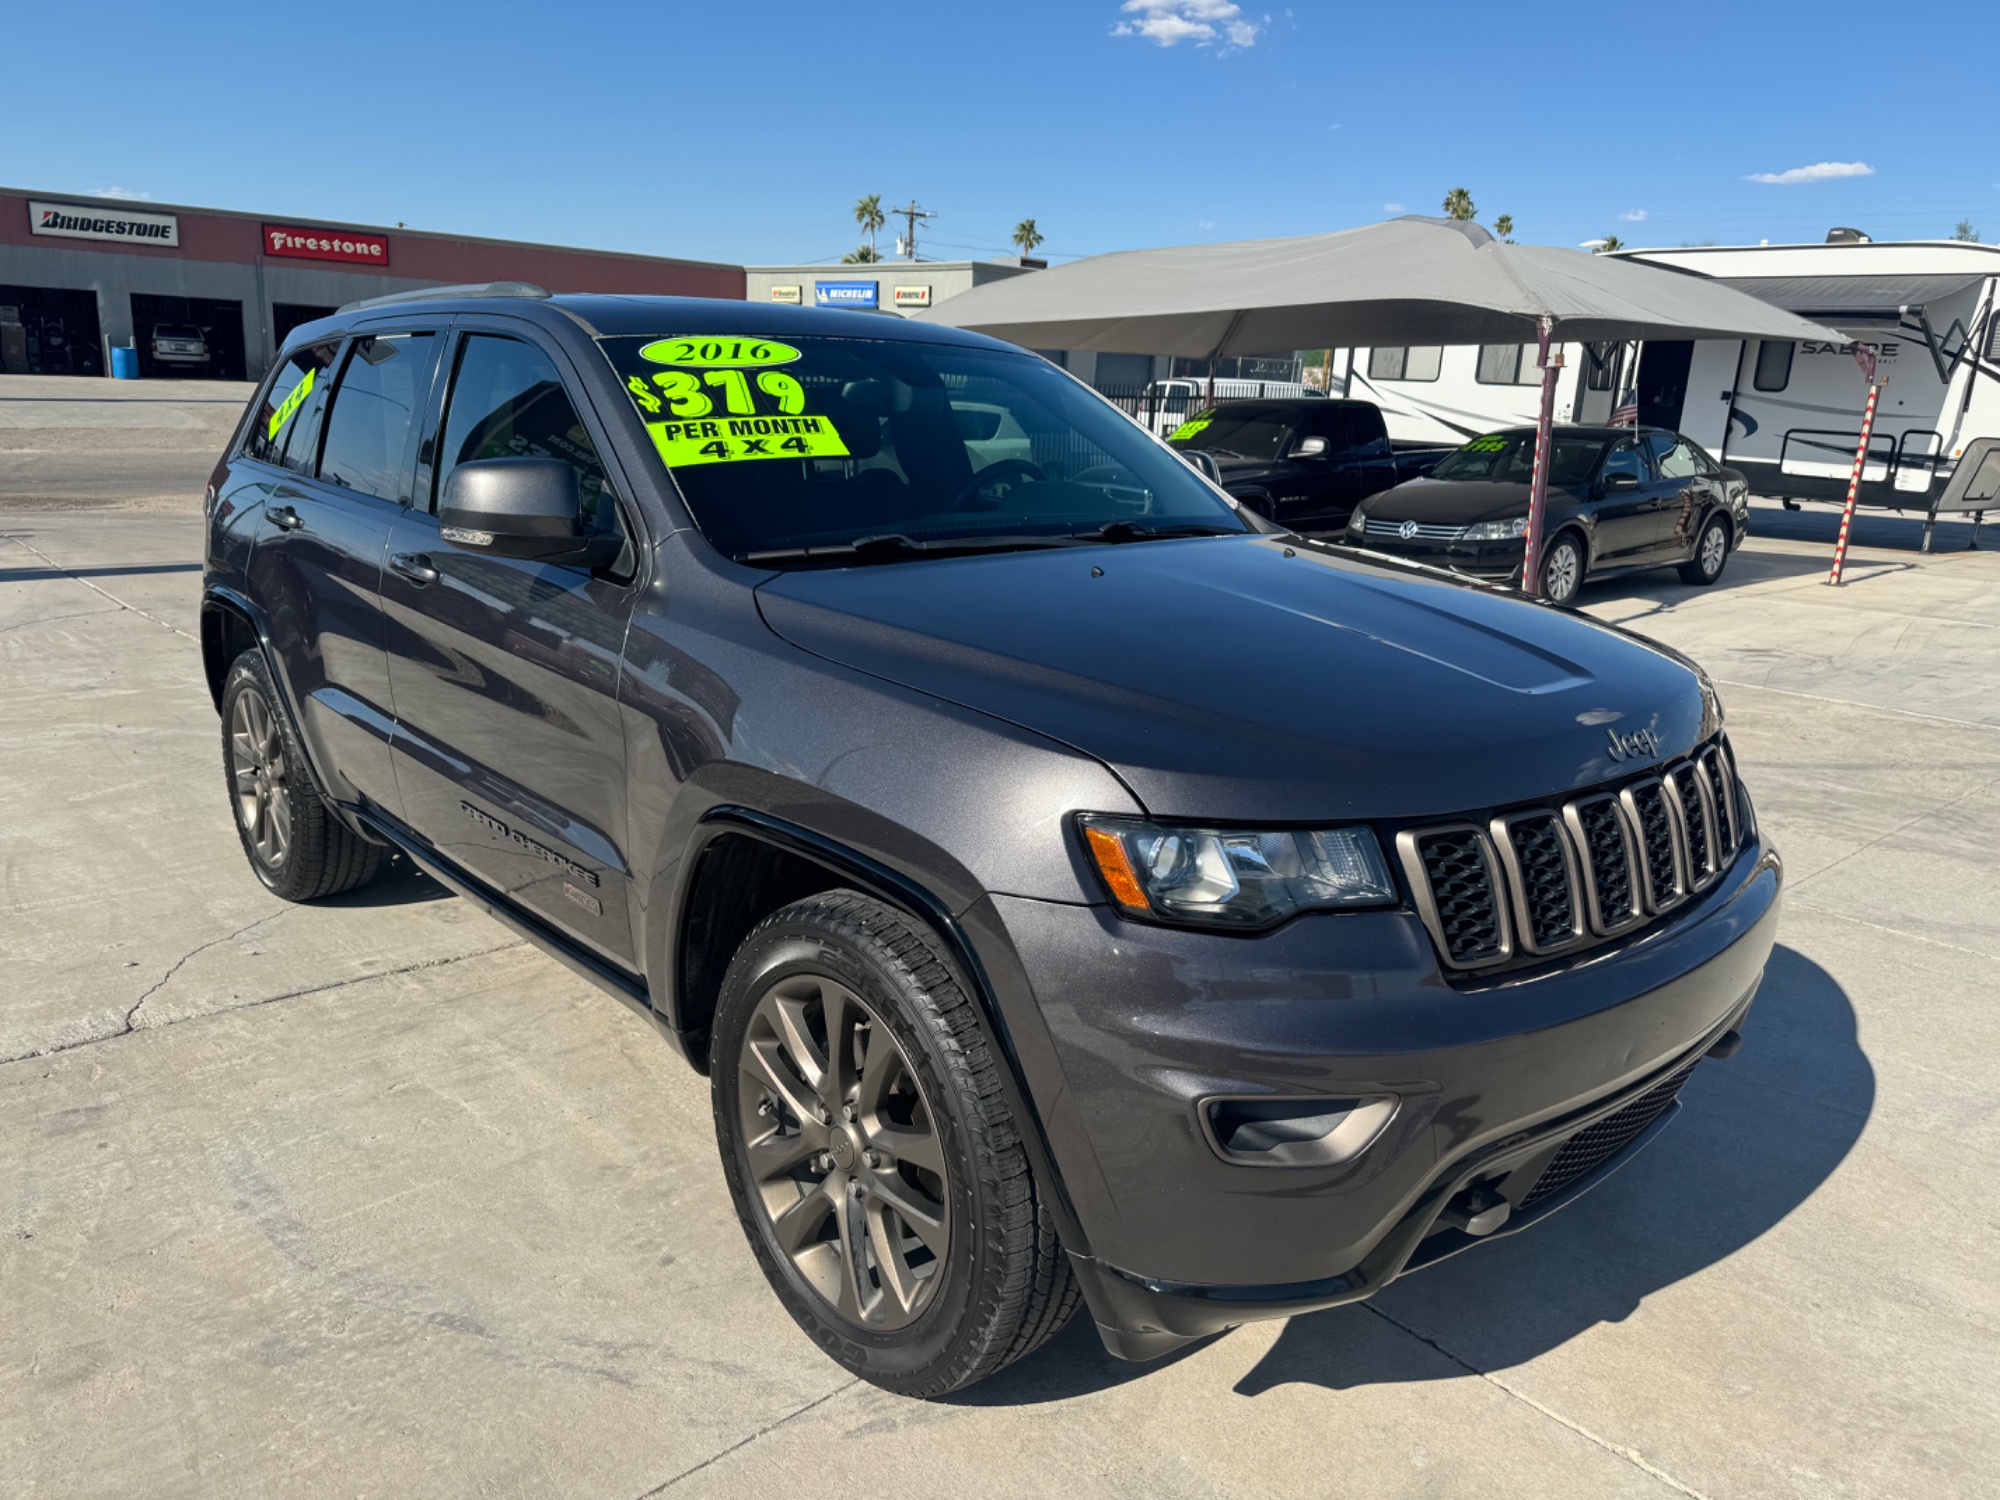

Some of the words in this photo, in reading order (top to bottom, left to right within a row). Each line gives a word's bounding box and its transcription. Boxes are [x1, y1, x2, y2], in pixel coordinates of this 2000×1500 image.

[39, 210, 172, 239] BRIDGESTONE
[270, 231, 382, 256] Firestone
[829, 288, 874, 299] MICHELIN
[674, 342, 772, 361] 2016
[628, 370, 806, 419] $379
[665, 421, 720, 441] PER
[728, 417, 822, 437] MONTH
[1605, 727, 1658, 763] Jeep
[511, 829, 601, 888] CHEROKEE
